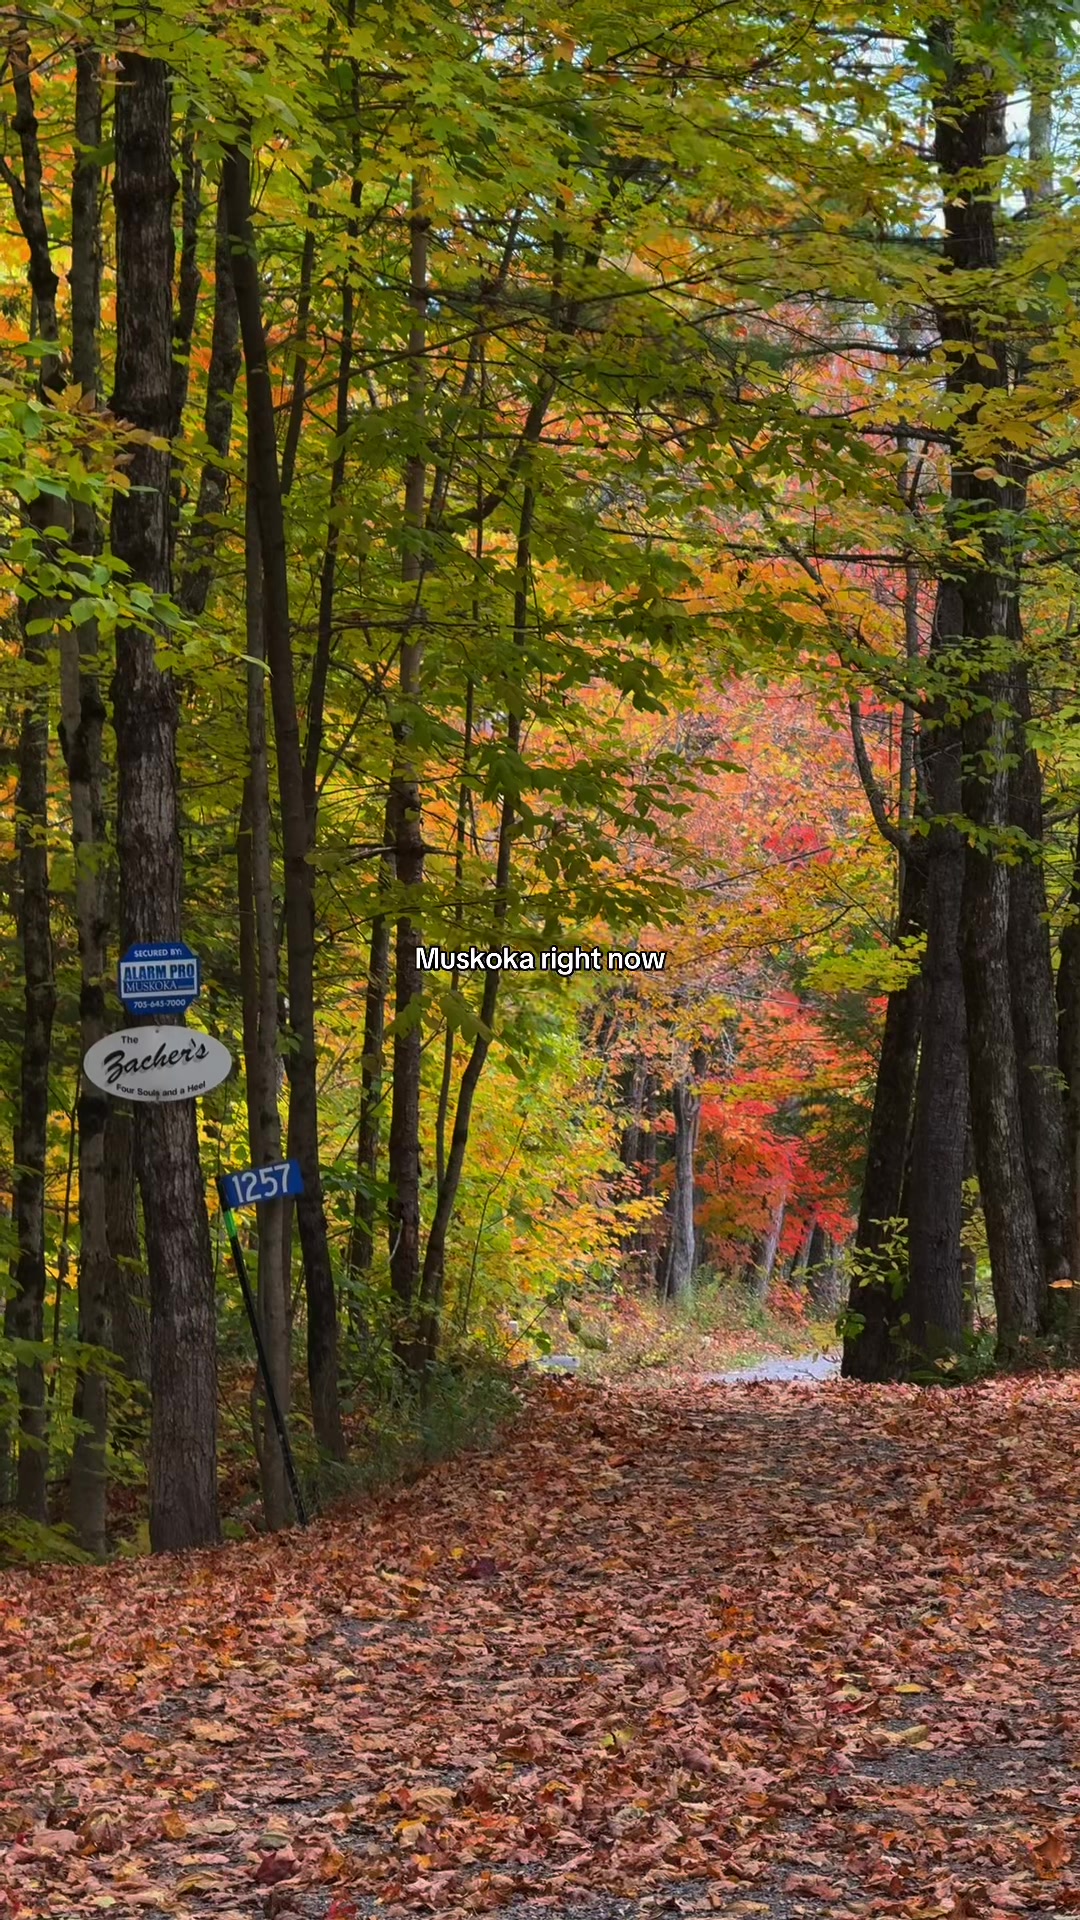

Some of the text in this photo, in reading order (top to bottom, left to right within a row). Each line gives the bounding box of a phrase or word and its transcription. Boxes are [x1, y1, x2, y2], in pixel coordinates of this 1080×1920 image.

[134, 948, 182, 958] SECURED BY:
[124, 963, 195, 981] ALARM PRO
[126, 980, 177, 993] MUSKOKA
[133, 999, 186, 1009] 705-645-7000
[121, 1035, 139, 1044] The
[103, 1038, 209, 1084] Zacher's
[116, 1083, 135, 1094] Four
[137, 1087, 160, 1097] Souls
[162, 1087, 178, 1096] and
[187, 1081, 206, 1093] Heel
[231, 1163, 290, 1203] 1257
